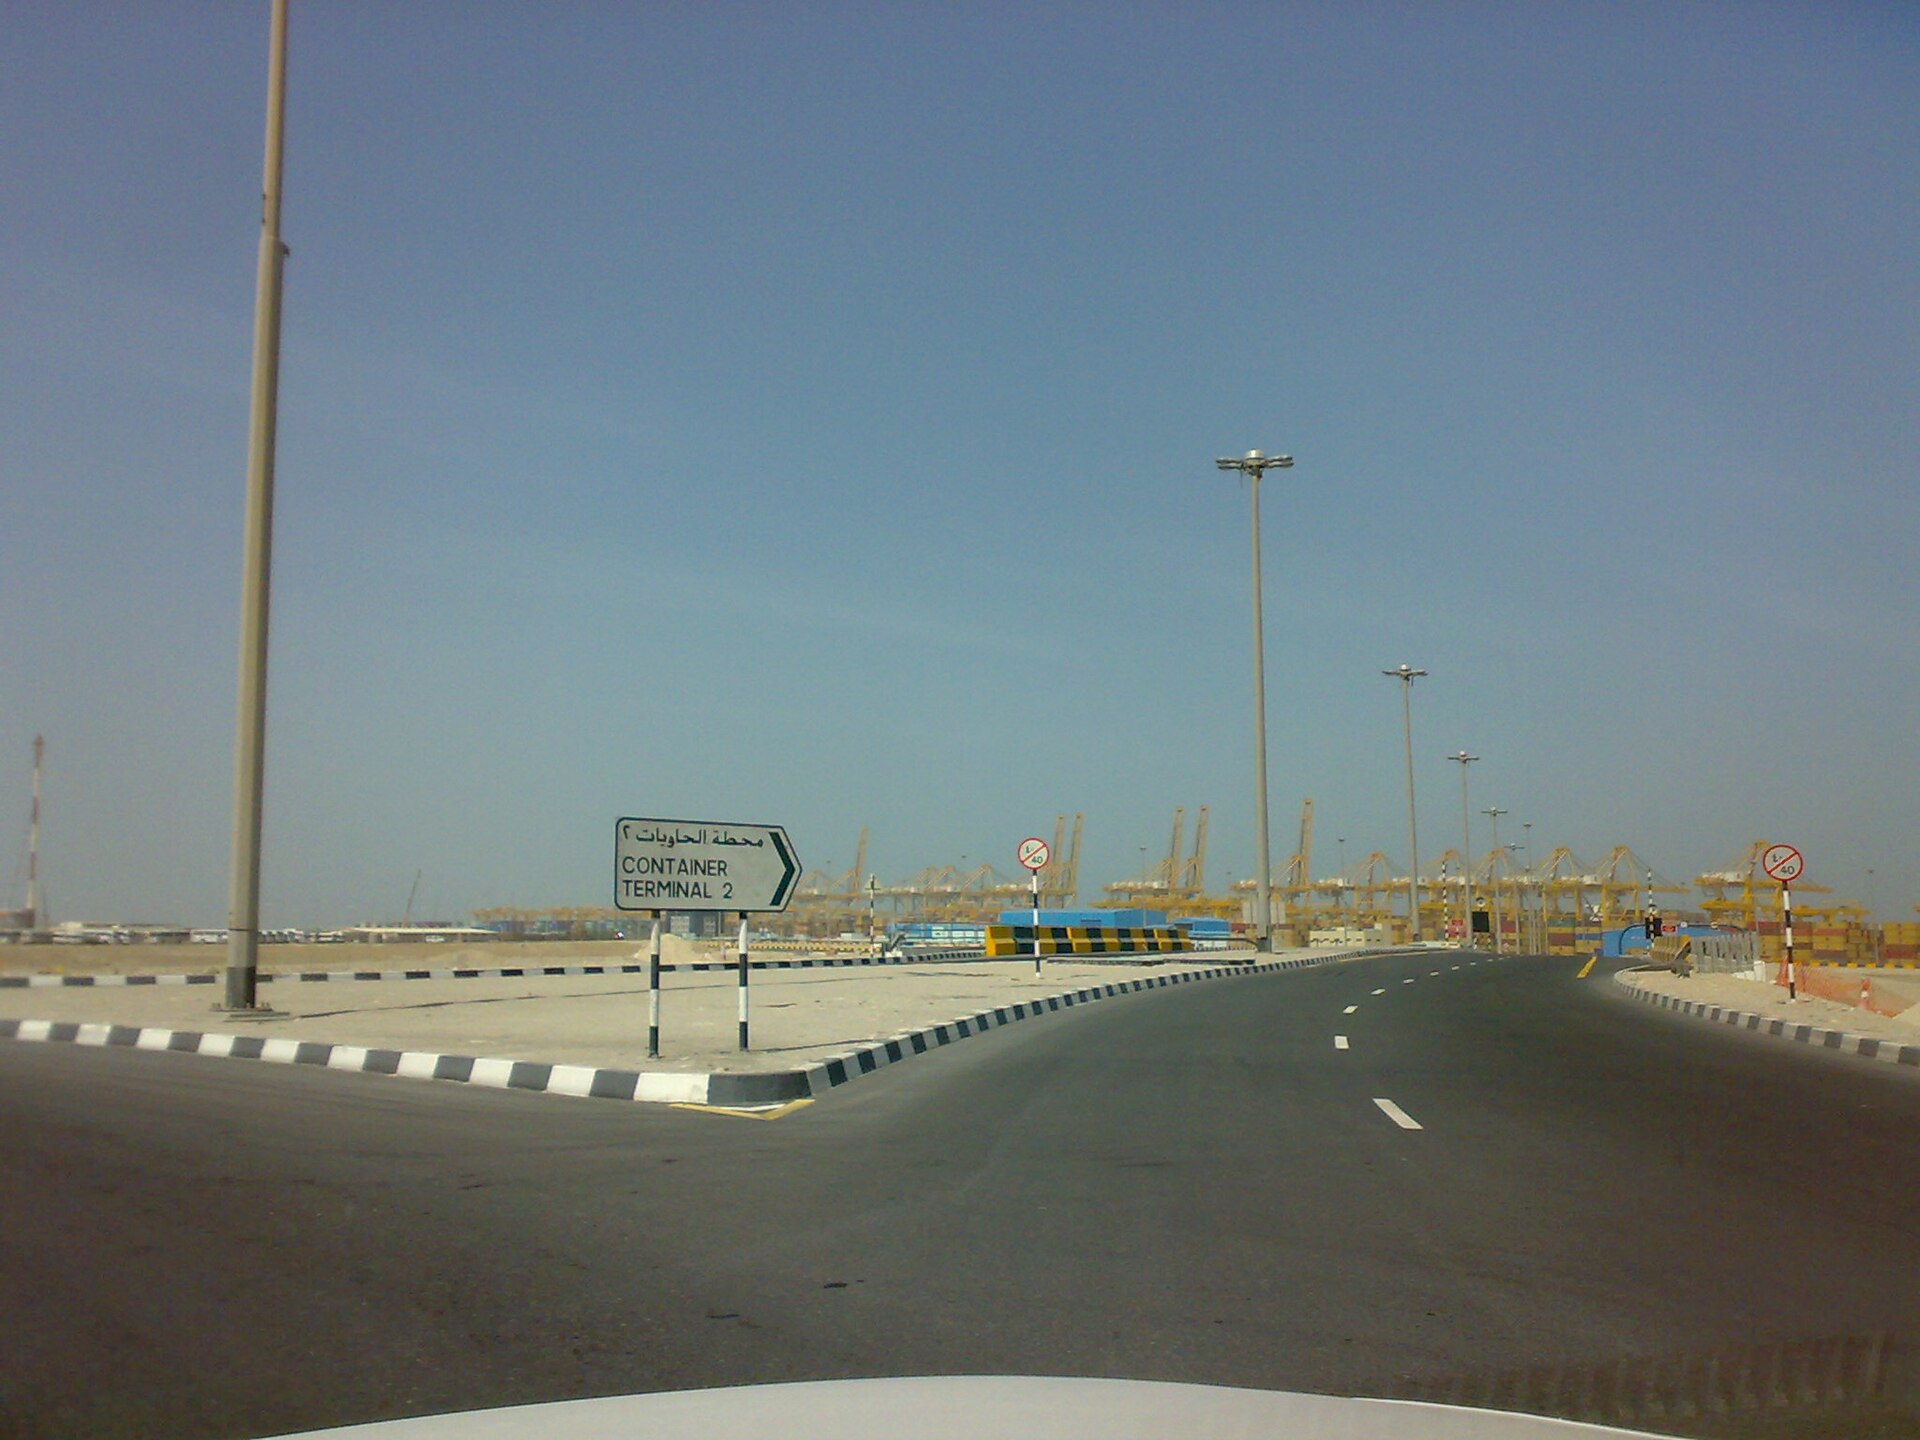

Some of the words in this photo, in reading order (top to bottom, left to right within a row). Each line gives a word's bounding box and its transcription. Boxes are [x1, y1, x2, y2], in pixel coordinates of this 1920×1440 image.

[636, 827, 706, 848] الحاويات
[712, 830, 763, 847] محطة
[622, 856, 728, 876] CONTAINER
[1032, 856, 1043, 864] 40
[1781, 866, 1795, 874] 40
[623, 880, 712, 899] TERMINAL
[723, 882, 733, 899] 2
